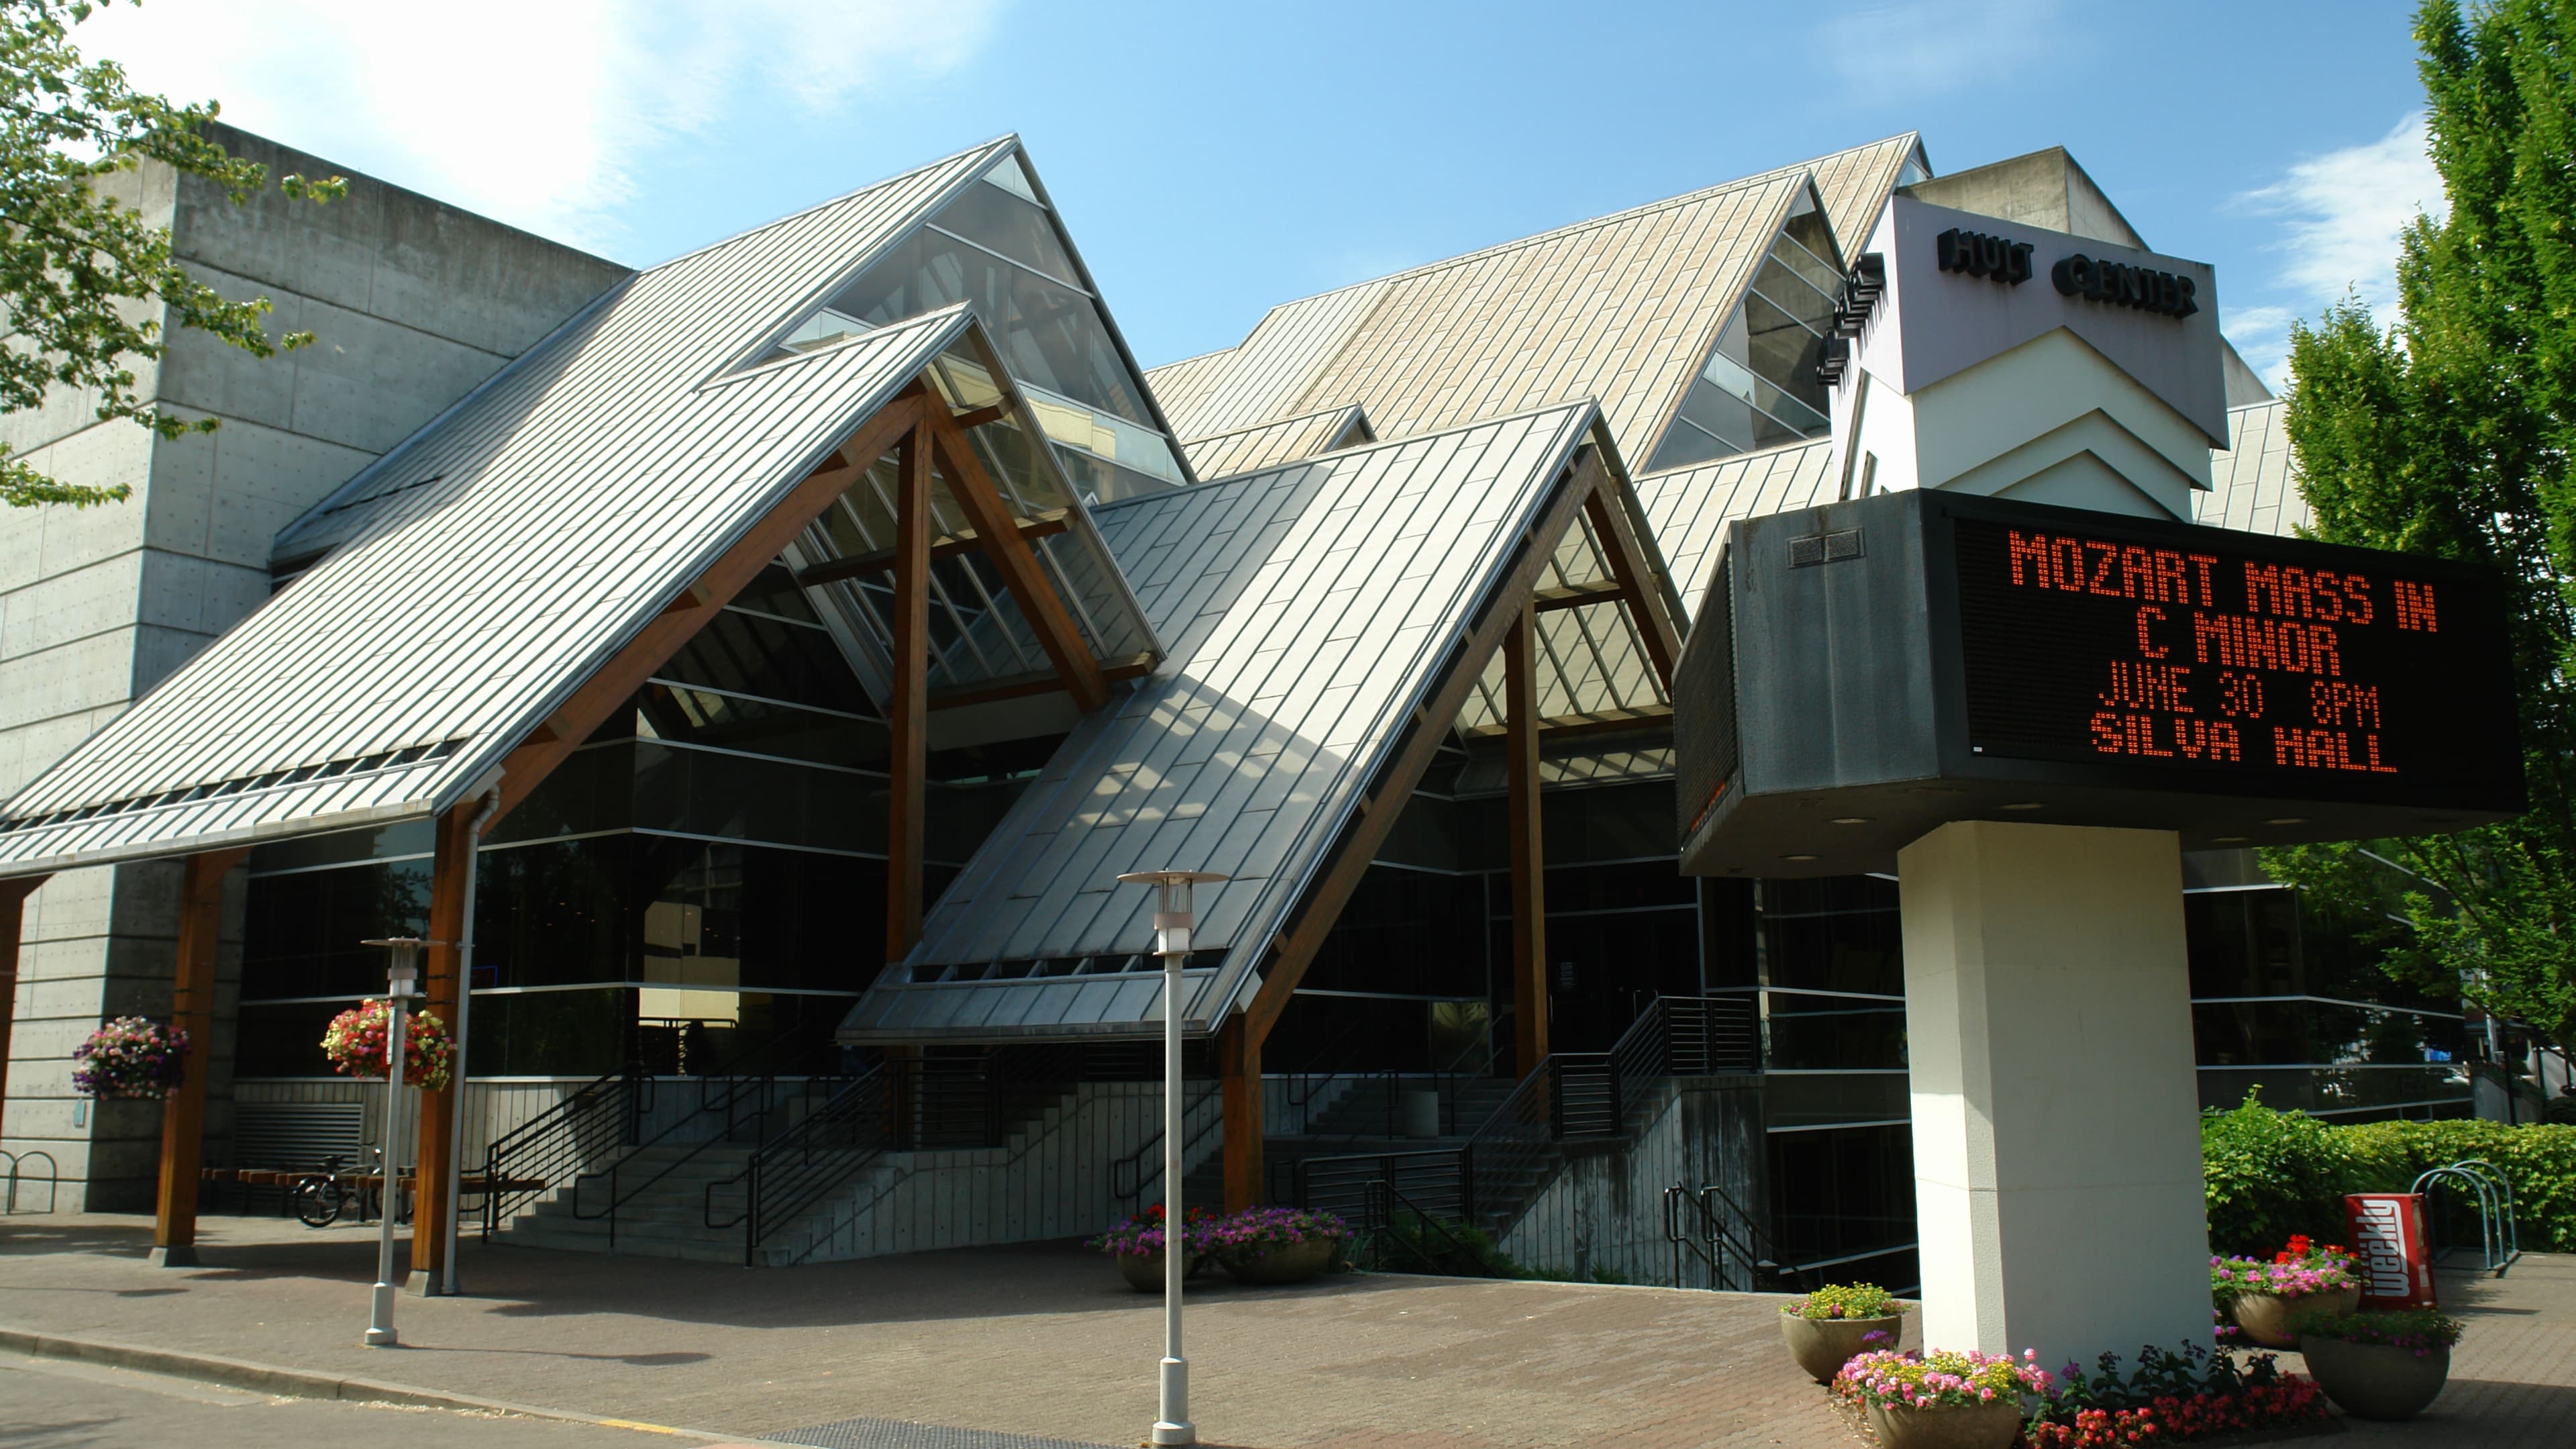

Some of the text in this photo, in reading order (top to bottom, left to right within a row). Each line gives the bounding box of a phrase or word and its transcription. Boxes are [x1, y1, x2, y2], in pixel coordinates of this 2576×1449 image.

[1937, 227, 2200, 319] HULT CENTER
[2009, 530, 2437, 632] MOZART MASS IN
[2136, 606, 2340, 676] C MINOR
[2098, 661, 2380, 728] JUNE 30 8PM
[2090, 712, 2398, 772] SILVA HALL
